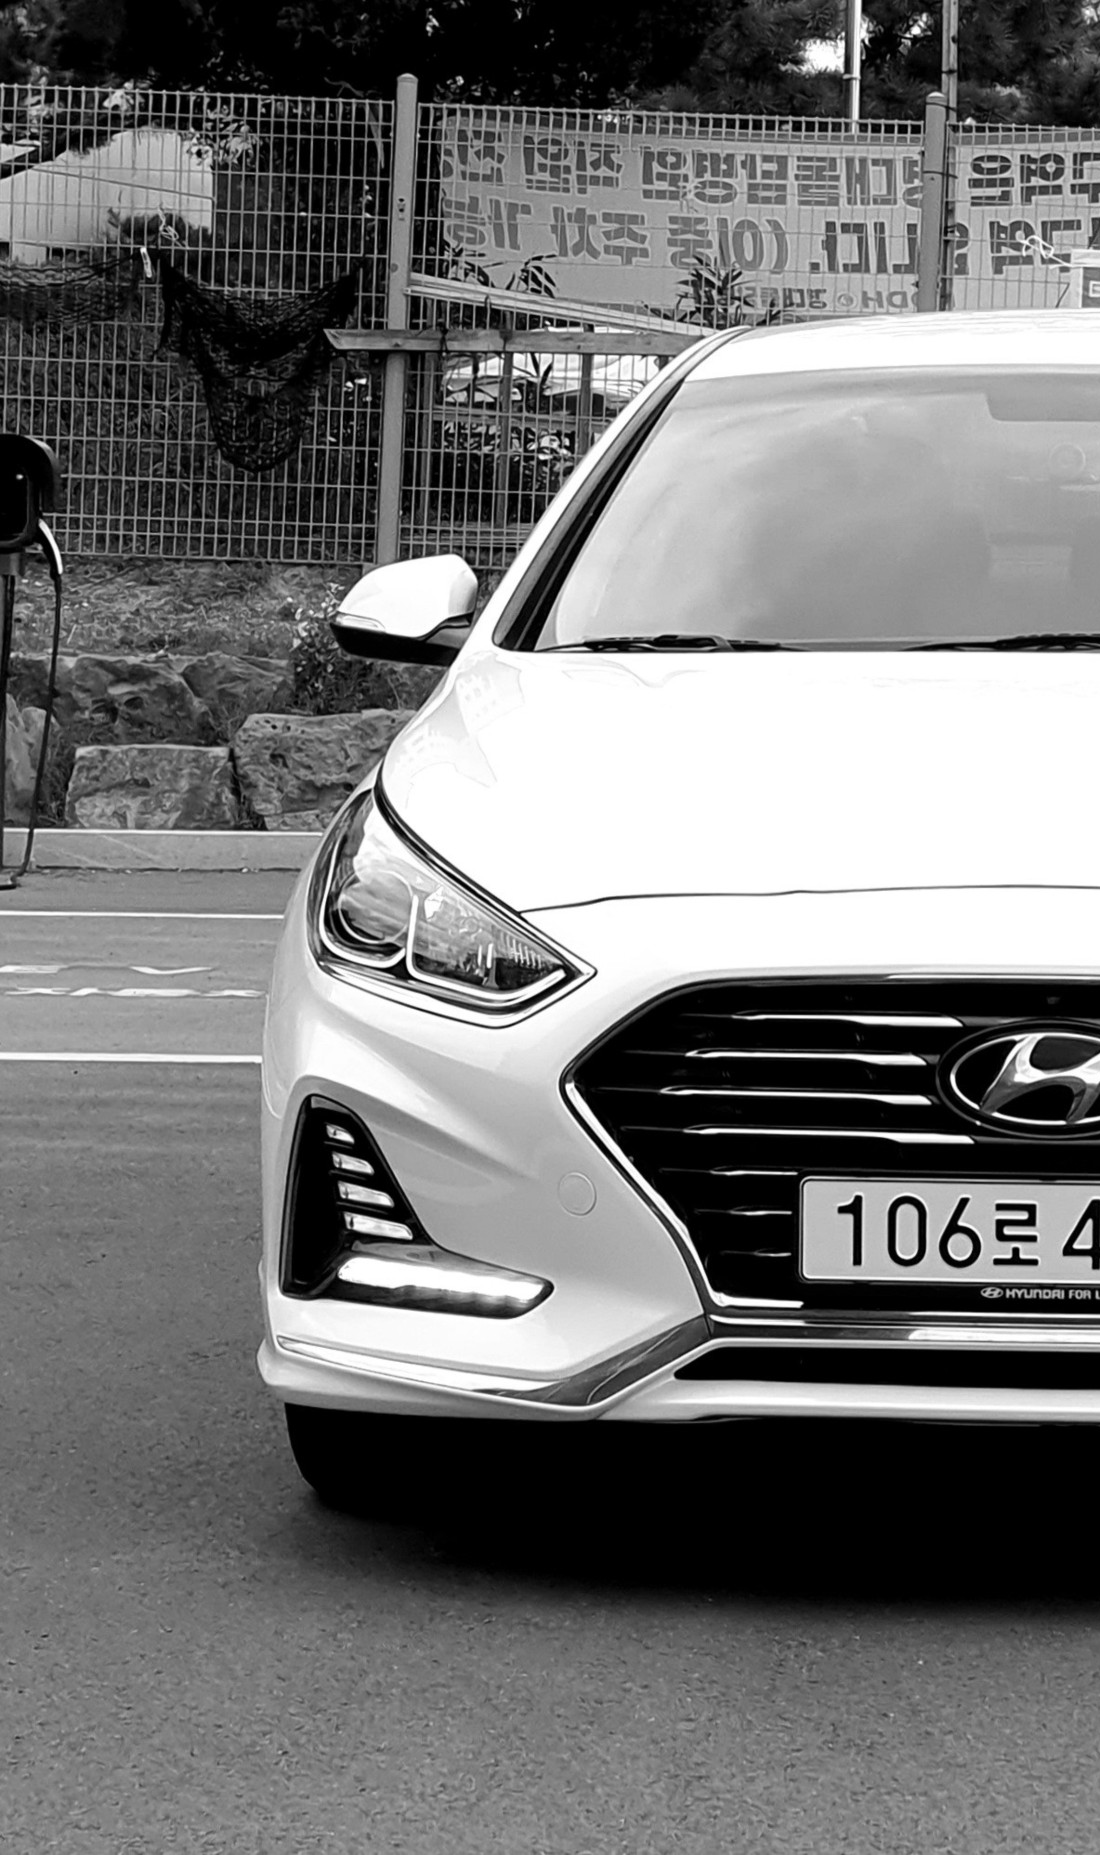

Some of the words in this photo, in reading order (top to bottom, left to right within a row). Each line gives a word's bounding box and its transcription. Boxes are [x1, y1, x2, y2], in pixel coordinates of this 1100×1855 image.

[836, 1193, 1040, 1268] 106로
[1005, 1288, 1065, 1299] HYUNDAI
[1068, 1289, 1092, 1300] FOR
